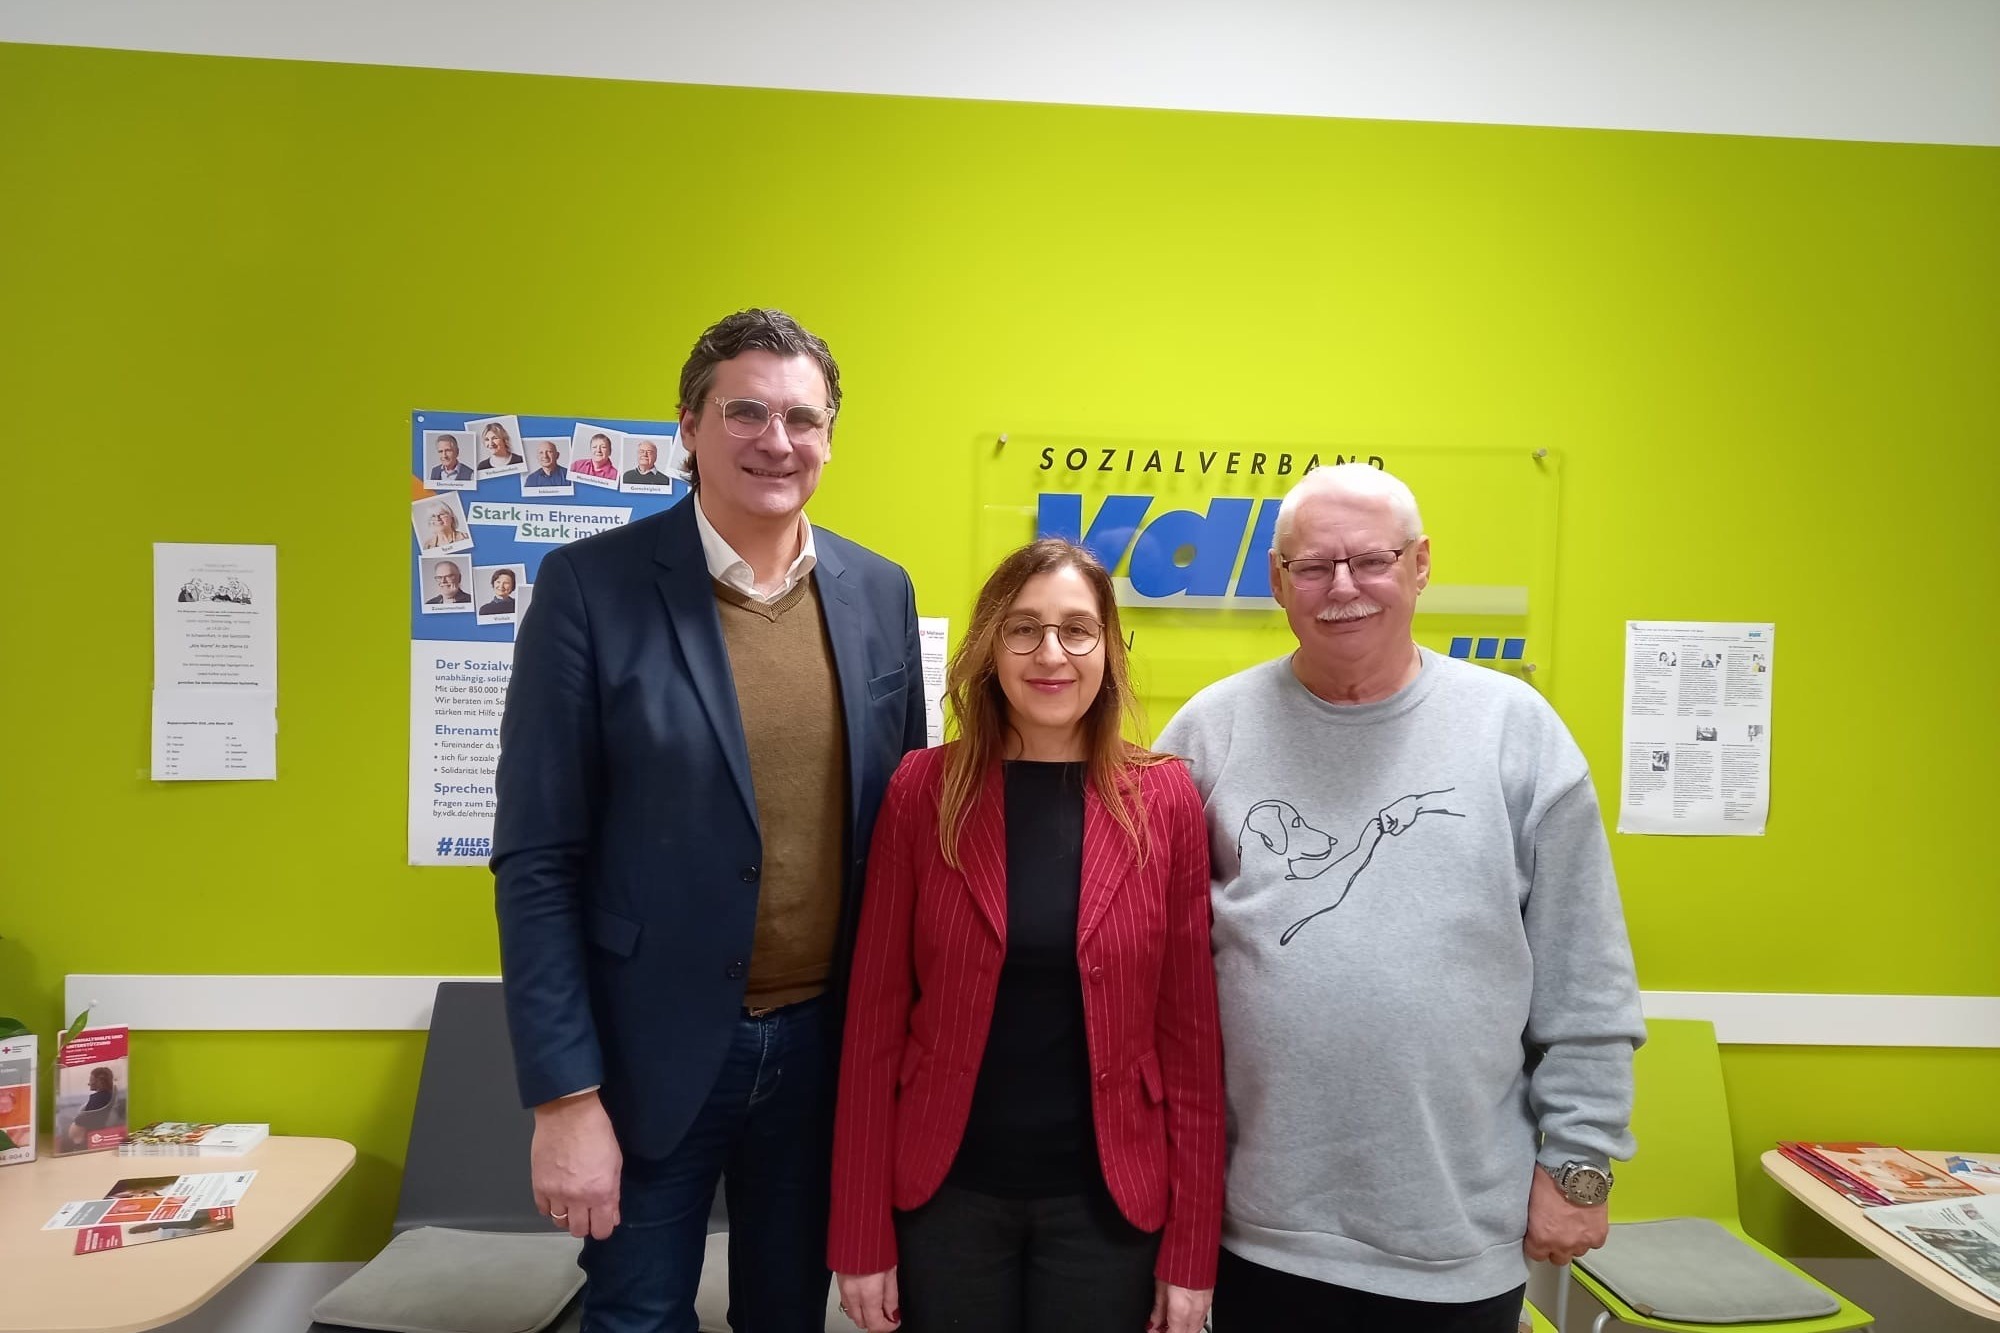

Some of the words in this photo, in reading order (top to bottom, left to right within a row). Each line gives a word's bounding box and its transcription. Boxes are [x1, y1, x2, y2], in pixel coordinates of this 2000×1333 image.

[472, 505, 520, 521] Stark
[525, 510, 544, 522] im
[550, 511, 624, 525] Ehrenamt.
[521, 523, 570, 538] Stark
[574, 527, 592, 539] im
[1038, 493, 1283, 599] Vd
[436, 659, 461, 670] Der
[435, 685, 448, 693] Mit
[449, 685, 467, 693] über
[468, 686, 498, 694] 850.000
[435, 696, 451, 704] Wir
[452, 697, 482, 705] beraten
[435, 708, 462, 716] stärken
[478, 709, 496, 717] Hilfe
[435, 724, 499, 736] Ehrenamt
[441, 741, 484, 749] füreinander
[485, 741, 495, 749] da
[441, 753, 456, 761] sich
[440, 766, 479, 774] Solidarität
[434, 782, 493, 795] Sprechen
[433, 800, 463, 808] Fragen
